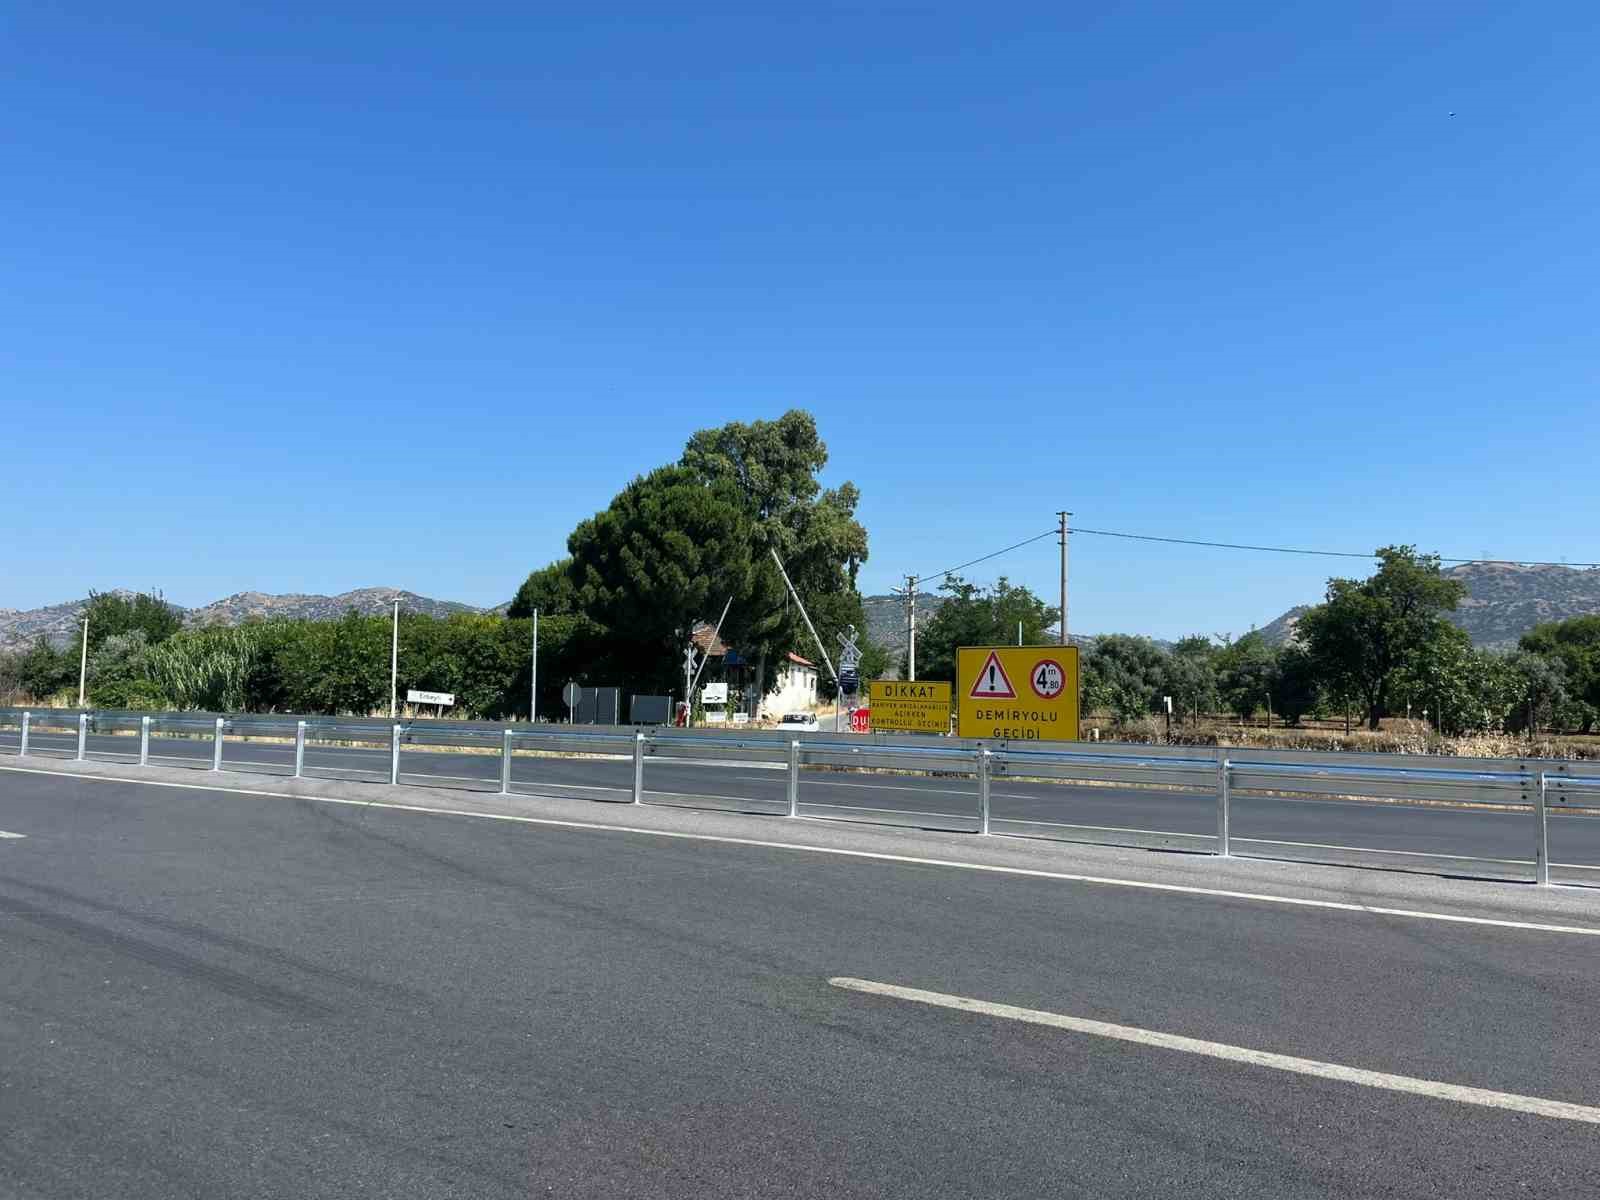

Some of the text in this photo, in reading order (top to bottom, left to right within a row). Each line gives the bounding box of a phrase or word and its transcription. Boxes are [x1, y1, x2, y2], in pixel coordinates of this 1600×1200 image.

[1036, 667, 1048, 689] 4
[885, 683, 935, 698] DİKKAT
[976, 708, 1058, 722] DEMİRYOLU
